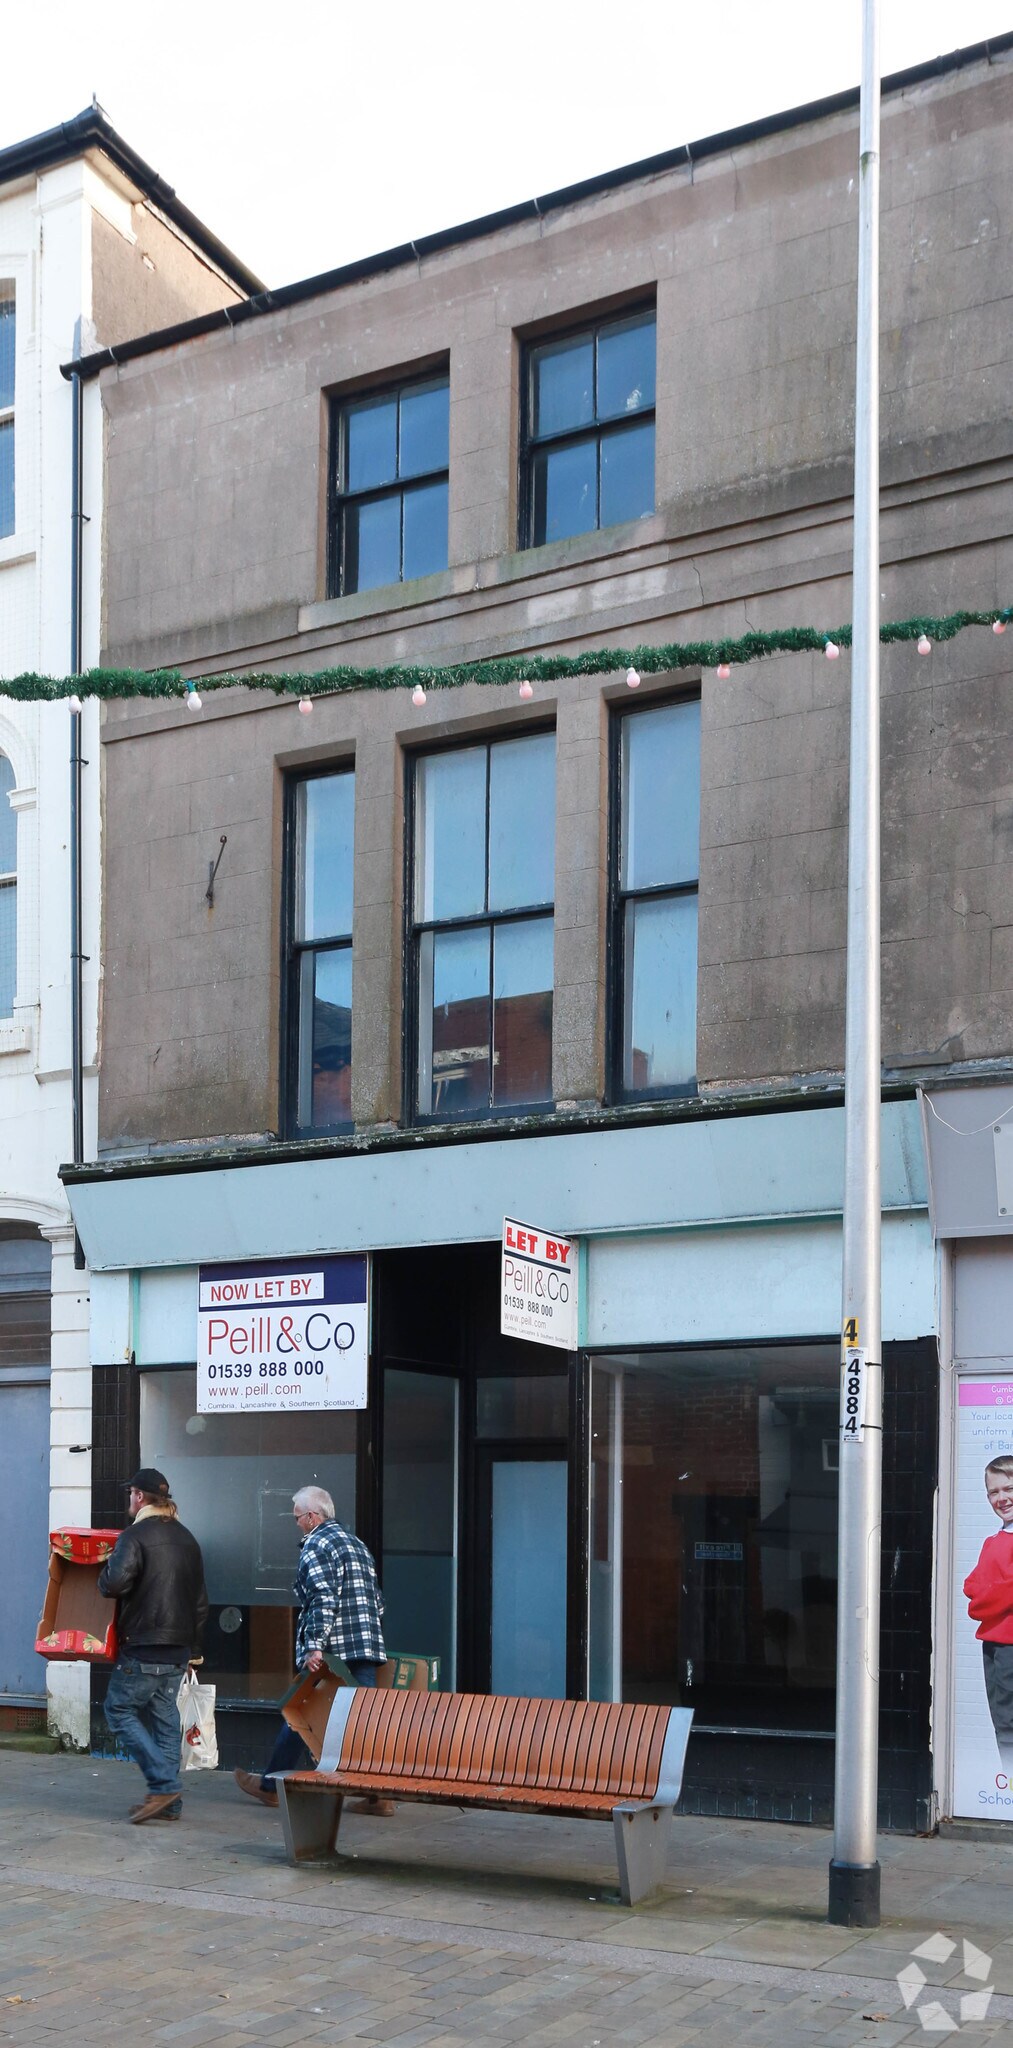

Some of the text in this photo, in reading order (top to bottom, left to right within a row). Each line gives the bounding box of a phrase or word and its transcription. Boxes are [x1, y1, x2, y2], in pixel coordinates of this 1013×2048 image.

[506, 1226, 570, 1264] LET BY
[211, 1279, 312, 1302] NOW LET BY
[505, 1259, 569, 1303] Peill&Co
[504, 1294, 553, 1317] 01539 888 000
[209, 1313, 355, 1355] Peill&Co
[208, 1360, 324, 1379] 01539 888 000
[288, 1400, 320, 1408] Southern
[845, 1358, 861, 1433] 4884
[971, 1412, 990, 1420] Your
[972, 1426, 1007, 1435] uniform
[984, 1441, 994, 1450] of
[979, 1790, 1013, 1805] Scho
